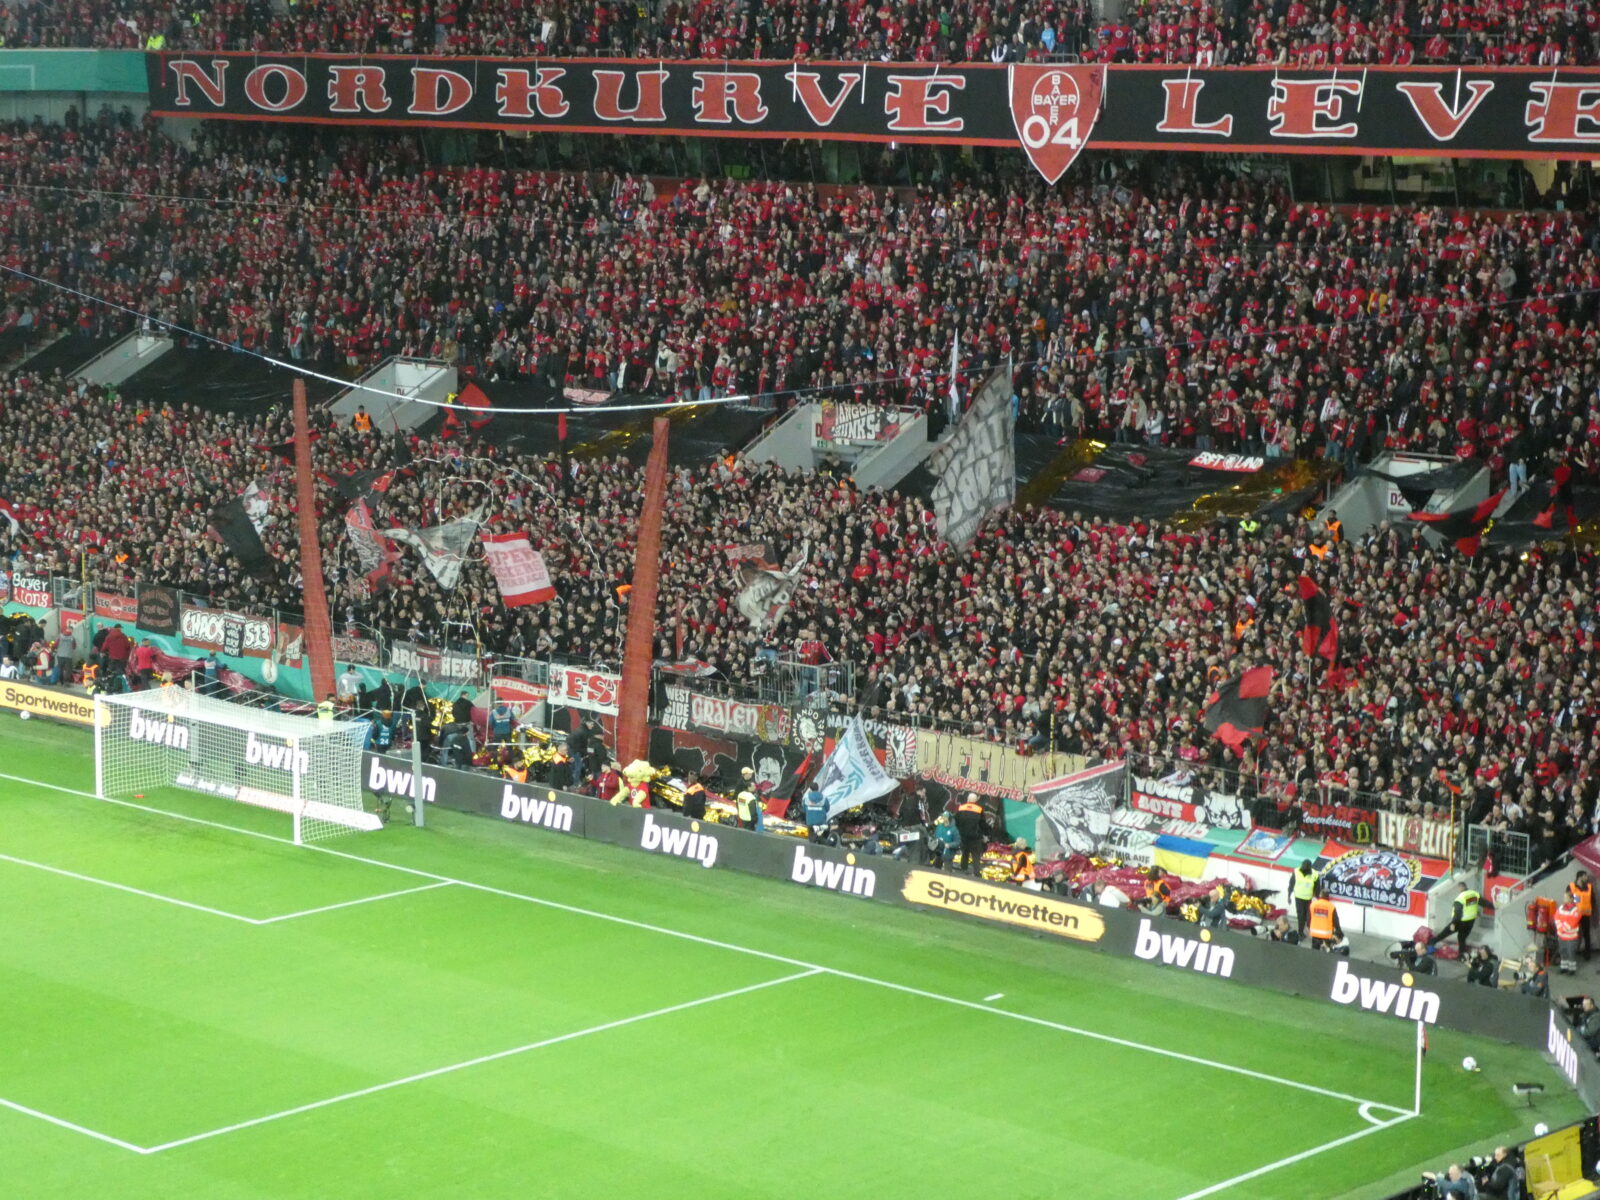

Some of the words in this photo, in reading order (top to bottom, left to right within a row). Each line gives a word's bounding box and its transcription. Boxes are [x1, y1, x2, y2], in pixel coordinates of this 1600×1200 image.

[1033, 94, 1077, 106] BAYER
[1050, 75, 1061, 126] BAYER
[1023, 115, 1082, 149] 04
[12, 572, 49, 592] Bayer
[13, 587, 49, 608] Lions
[5, 687, 96, 719] Sportwetten
[665, 685, 690, 703] WEST
[129, 708, 189, 750] bwin
[661, 713, 689, 730] BOYZ
[245, 730, 310, 774] bwin
[501, 784, 573, 831] bwin
[640, 813, 719, 867] bwin
[791, 845, 876, 897] bwin
[927, 881, 1079, 930] Sportwetten
[1134, 918, 1235, 978] bwin
[1330, 960, 1441, 1024] bwin
[1547, 1008, 1578, 1085] bwin
